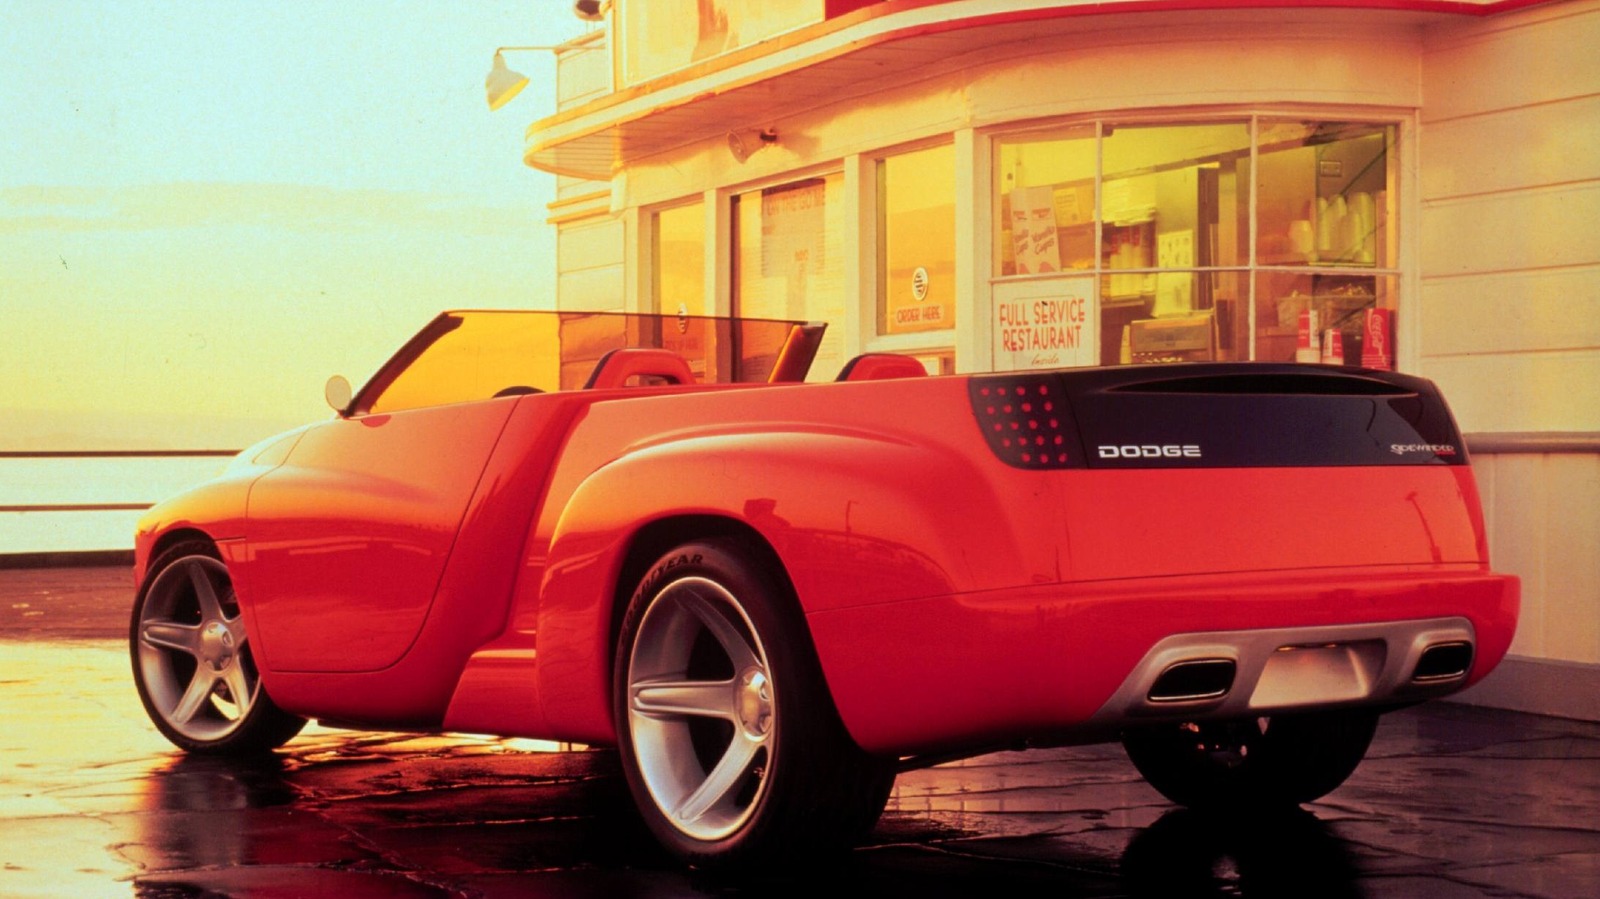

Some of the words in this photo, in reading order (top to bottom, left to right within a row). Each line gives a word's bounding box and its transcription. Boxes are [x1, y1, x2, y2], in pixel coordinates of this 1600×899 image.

[898, 308, 920, 323] ORDER
[923, 305, 941, 320] HERE
[999, 303, 1028, 326] FULL
[1034, 298, 1085, 324] SERVICE
[1003, 325, 1081, 352] RESTAURANT
[1098, 445, 1201, 458] DODGE
